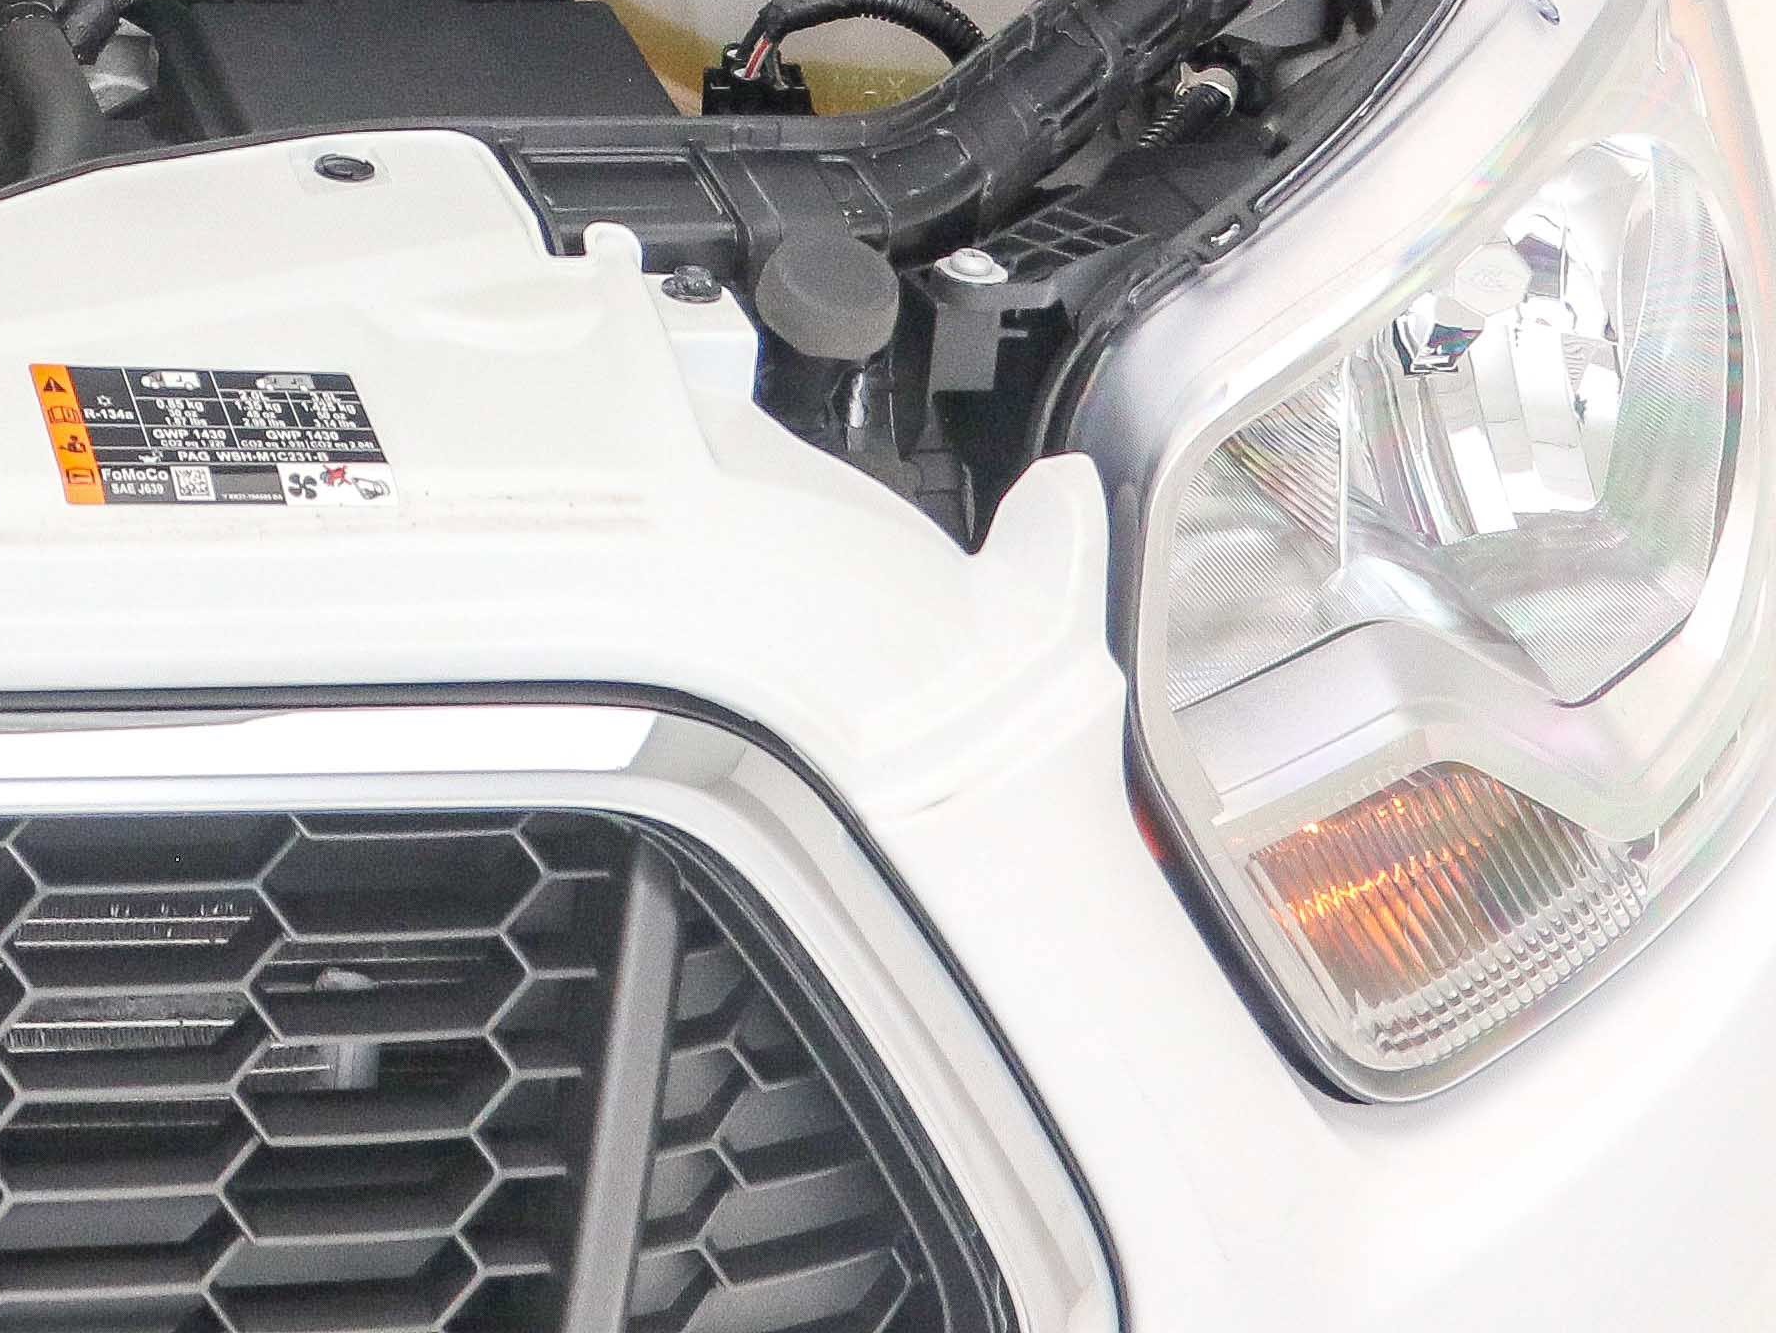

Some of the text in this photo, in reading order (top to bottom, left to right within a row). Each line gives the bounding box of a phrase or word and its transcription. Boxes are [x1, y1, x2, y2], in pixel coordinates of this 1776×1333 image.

[185, 399, 205, 412] kg
[264, 402, 282, 413] kg
[338, 403, 356, 414] kg
[83, 408, 135, 420] R-134a
[152, 428, 227, 440] GWP 1430
[266, 430, 339, 441] GWP 1430
[177, 451, 210, 461] PAG
[101, 468, 169, 481] FoMoCo
[110, 483, 137, 494] SAE
